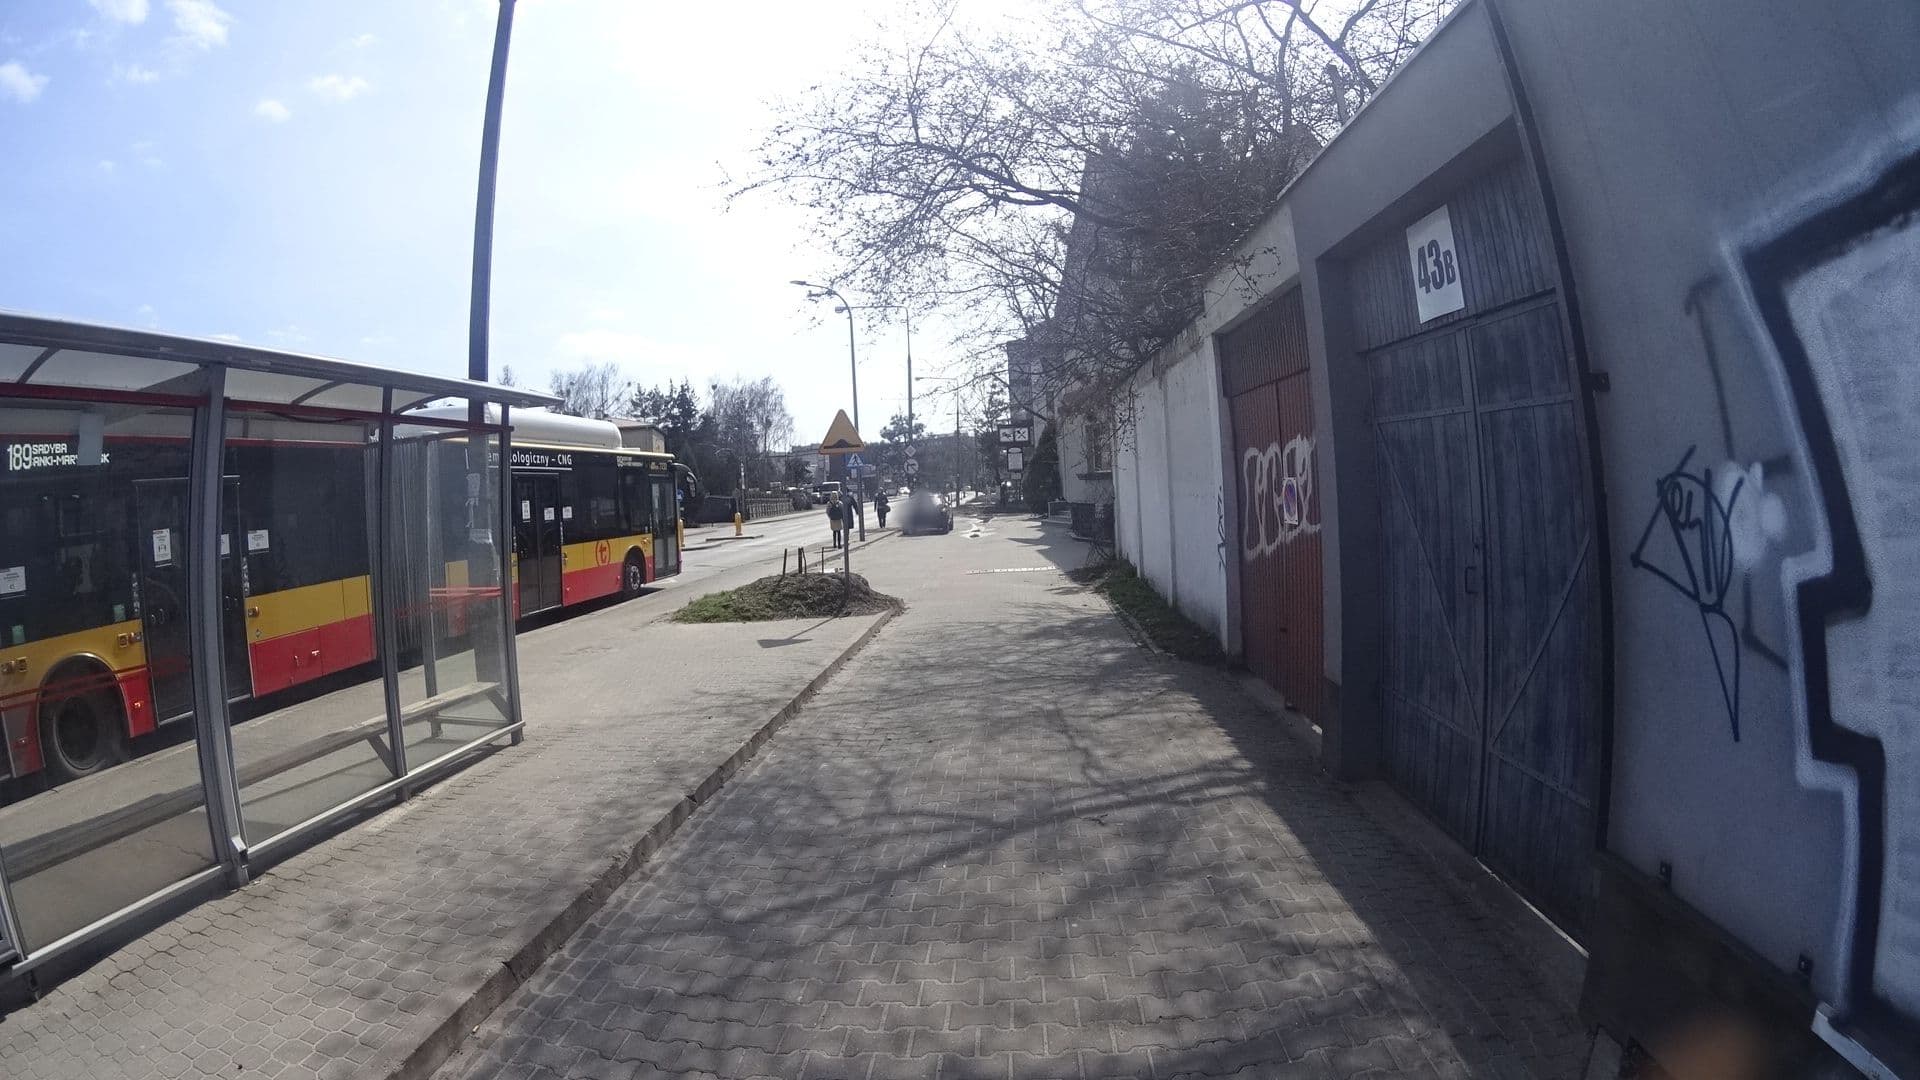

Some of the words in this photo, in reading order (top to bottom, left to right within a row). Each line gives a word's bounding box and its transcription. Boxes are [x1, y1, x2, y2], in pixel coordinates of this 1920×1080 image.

[1417, 239, 1456, 294] 43B
[7, 443, 32, 471] 189
[32, 443, 67, 454] SADYBA
[510, 450, 549, 466] ologiczny
[557, 453, 573, 465] CNG
